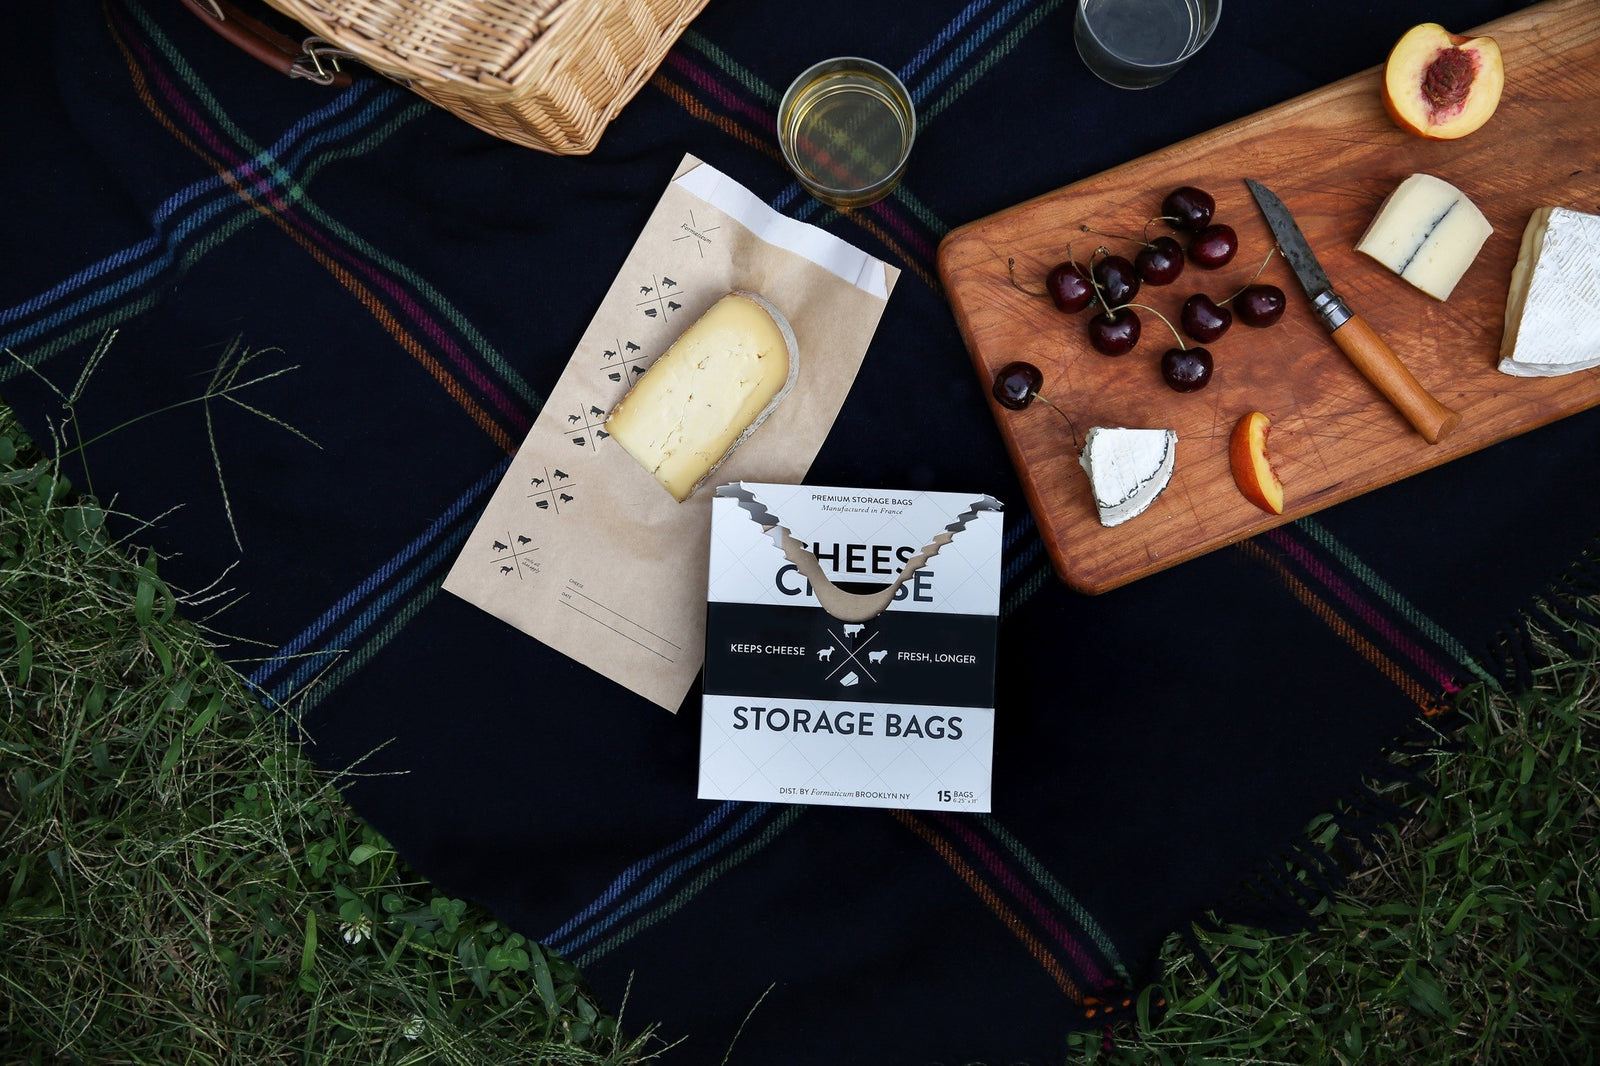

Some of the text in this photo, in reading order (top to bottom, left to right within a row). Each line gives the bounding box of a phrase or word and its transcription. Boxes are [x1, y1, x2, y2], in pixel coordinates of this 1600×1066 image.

[811, 494, 913, 506] PREMIUM STORAGE BAGS
[821, 504, 869, 514] Manufactured
[880, 507, 903, 515] France
[730, 643, 806, 656] KEEPS CHEESE
[897, 651, 976, 664] FRESH, LONGER
[733, 706, 963, 740] STORAGE BAGS
[779, 787, 798, 795] DIST.
[810, 788, 855, 798] Formaticum
[855, 791, 898, 799] BROOKLYN
[937, 790, 974, 803] 15 BAGS
